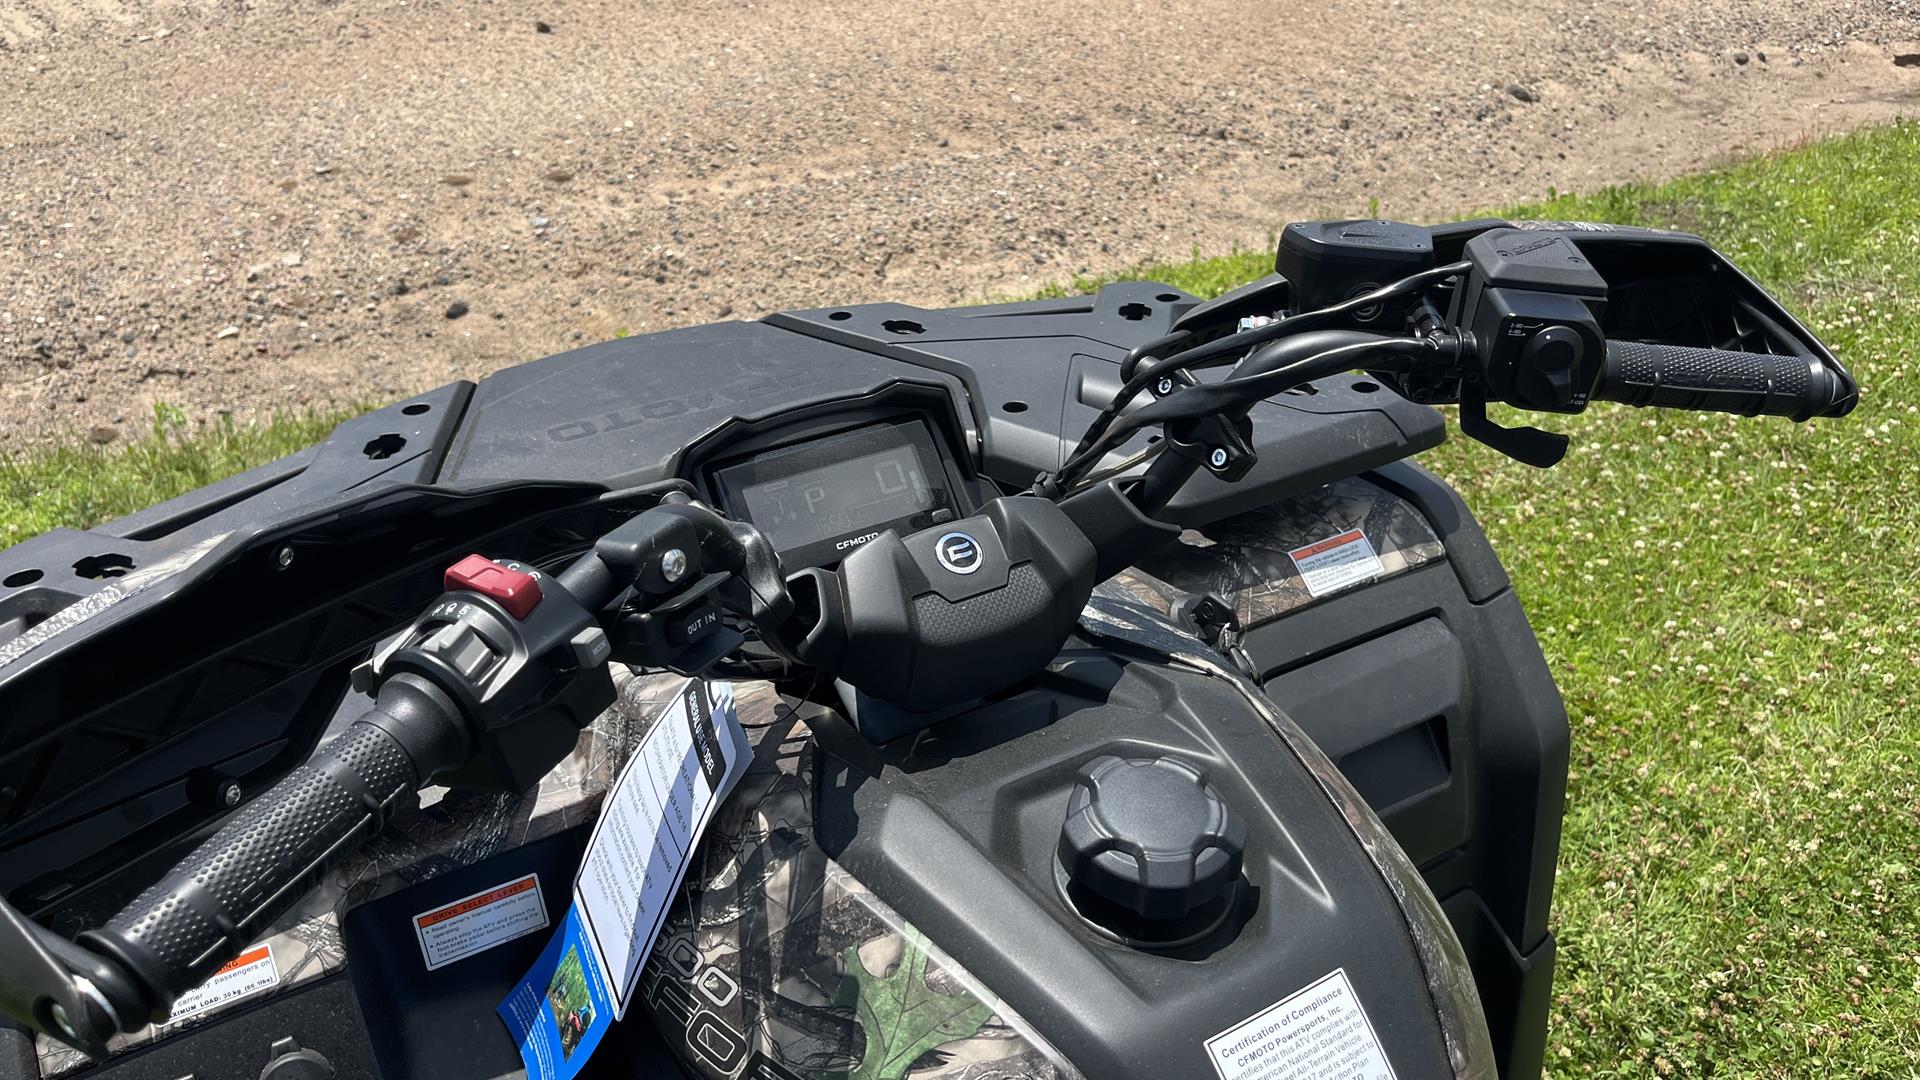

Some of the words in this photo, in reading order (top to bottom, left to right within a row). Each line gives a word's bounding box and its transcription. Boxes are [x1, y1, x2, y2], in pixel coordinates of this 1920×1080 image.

[804, 486, 825, 514] P
[836, 532, 880, 550] CFMOTO
[688, 618, 702, 634] OUT
[704, 612, 716, 624] IN
[700, 742, 715, 776] MODEL
[214, 964, 258, 984] passengers
[177, 993, 202, 1006] carrier
[199, 996, 220, 1007] LOAD:
[1221, 1022, 1280, 1058] Certification
[1281, 1014, 1291, 1026] of
[1290, 987, 1342, 1020] Compliance
[1237, 1041, 1275, 1067] CFMOTO
[1327, 1005, 1343, 1016] Inc.
[1262, 1052, 1280, 1067] that
[1279, 1045, 1295, 1057] this
[1294, 1034, 1310, 1049] ATV
[1310, 1017, 1344, 1040] complies
[1343, 1008, 1358, 1021] with
[1287, 1043, 1320, 1067] National
[1319, 1024, 1353, 1048] Standard
[1352, 1019, 1363, 1029] for
[1296, 1049, 1335, 1076] All-Terrain
[1334, 1034, 1361, 1053] Vehicle
[1318, 1064, 1333, 1077] and
[1340, 1044, 1367, 1065] subject
[1365, 1040, 1374, 1048] to
[1352, 1057, 1370, 1072] Plan
